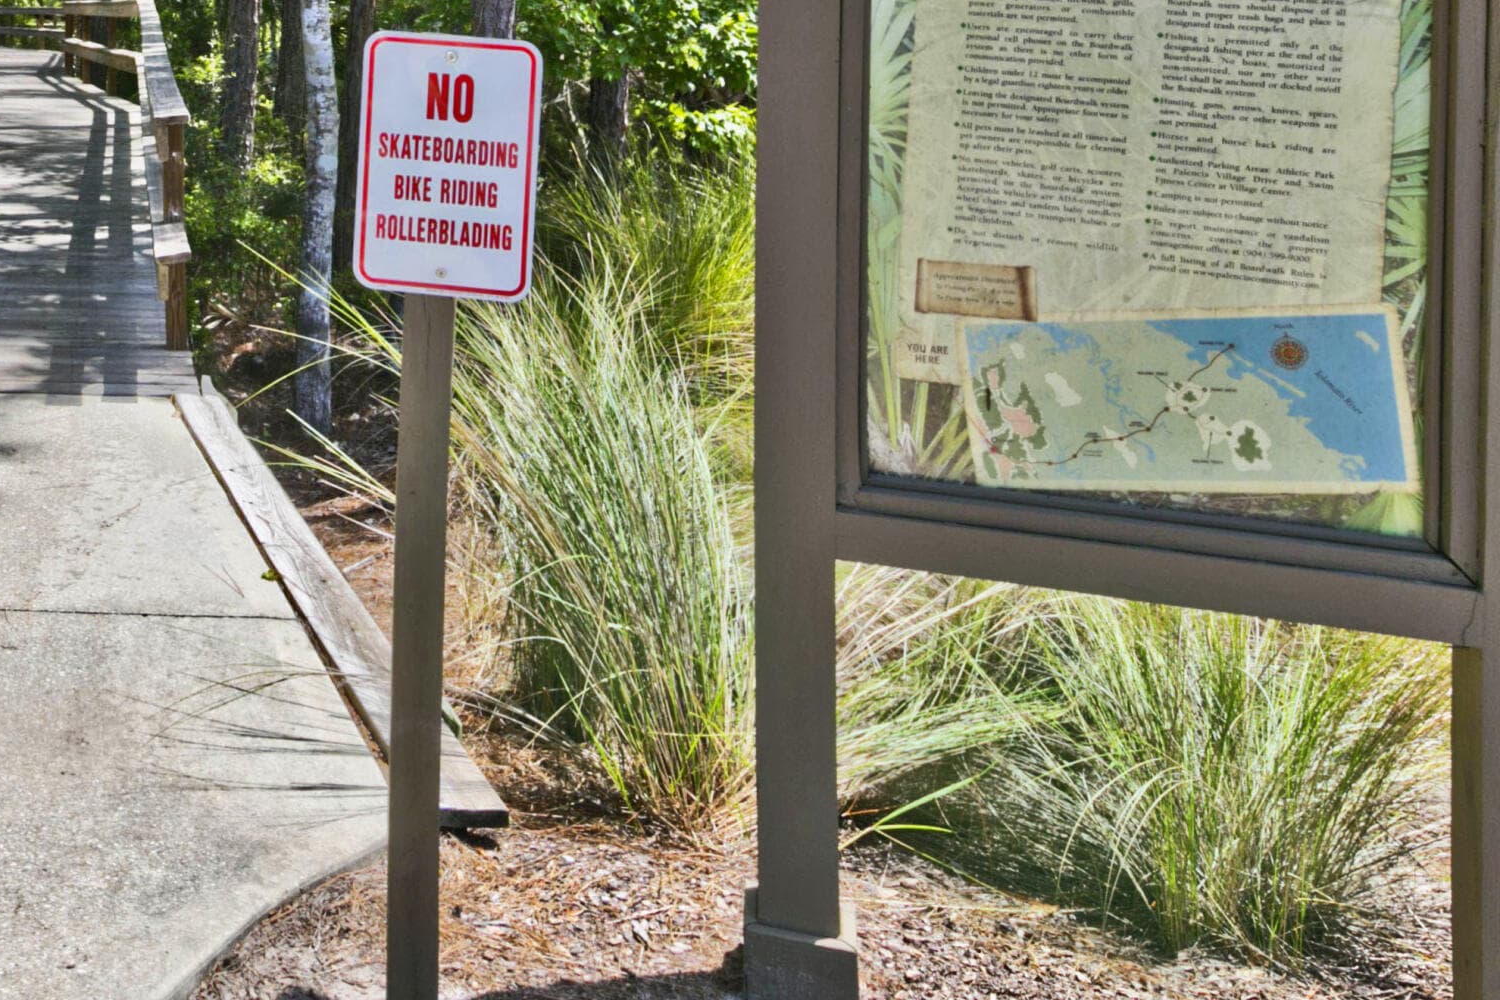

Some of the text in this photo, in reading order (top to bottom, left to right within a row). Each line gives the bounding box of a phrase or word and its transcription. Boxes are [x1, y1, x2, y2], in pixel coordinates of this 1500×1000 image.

[426, 72, 474, 123] NO
[378, 132, 518, 168] SKATEBOARDING
[394, 175, 498, 208] BIKE RIDING
[375, 214, 512, 250] ROLLERBLADING
[907, 344, 949, 355] YOU ARE
[915, 355, 940, 364] HERE
